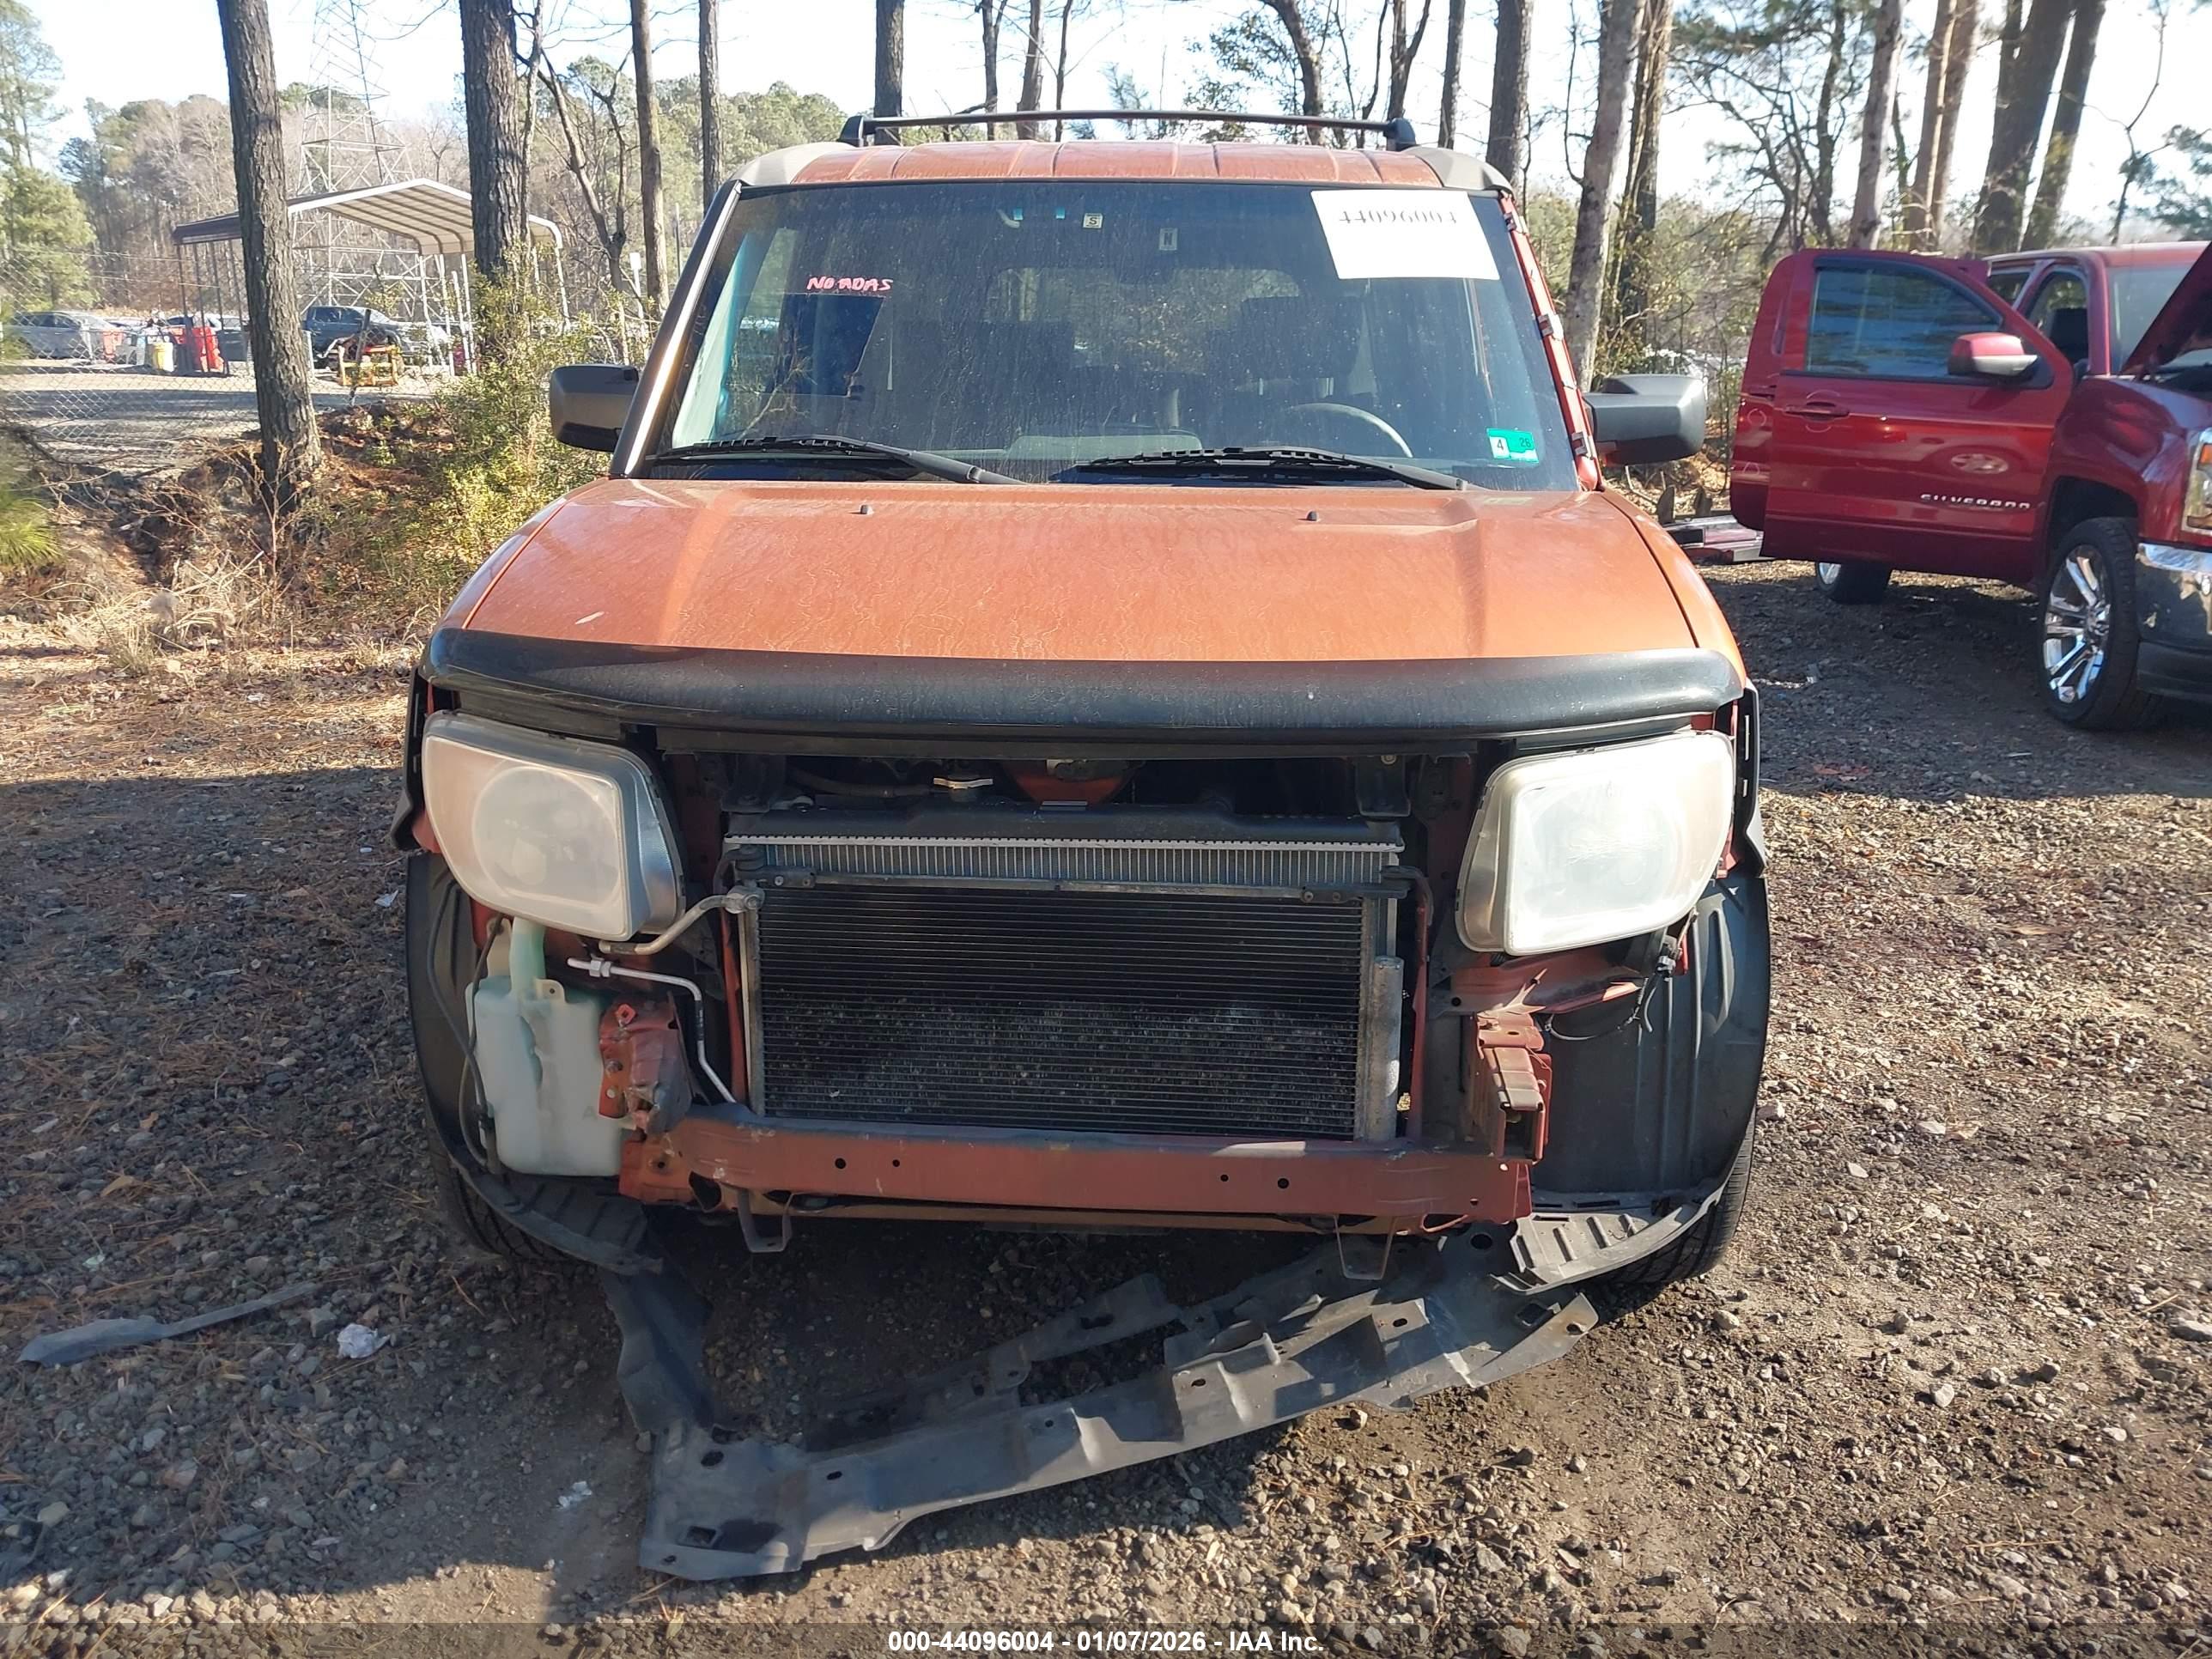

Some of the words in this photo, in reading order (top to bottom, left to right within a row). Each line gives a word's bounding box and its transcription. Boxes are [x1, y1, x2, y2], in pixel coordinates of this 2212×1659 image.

[806, 276, 836, 290] NO
[837, 276, 894, 292] ADAS
[1497, 439, 1504, 451] 4
